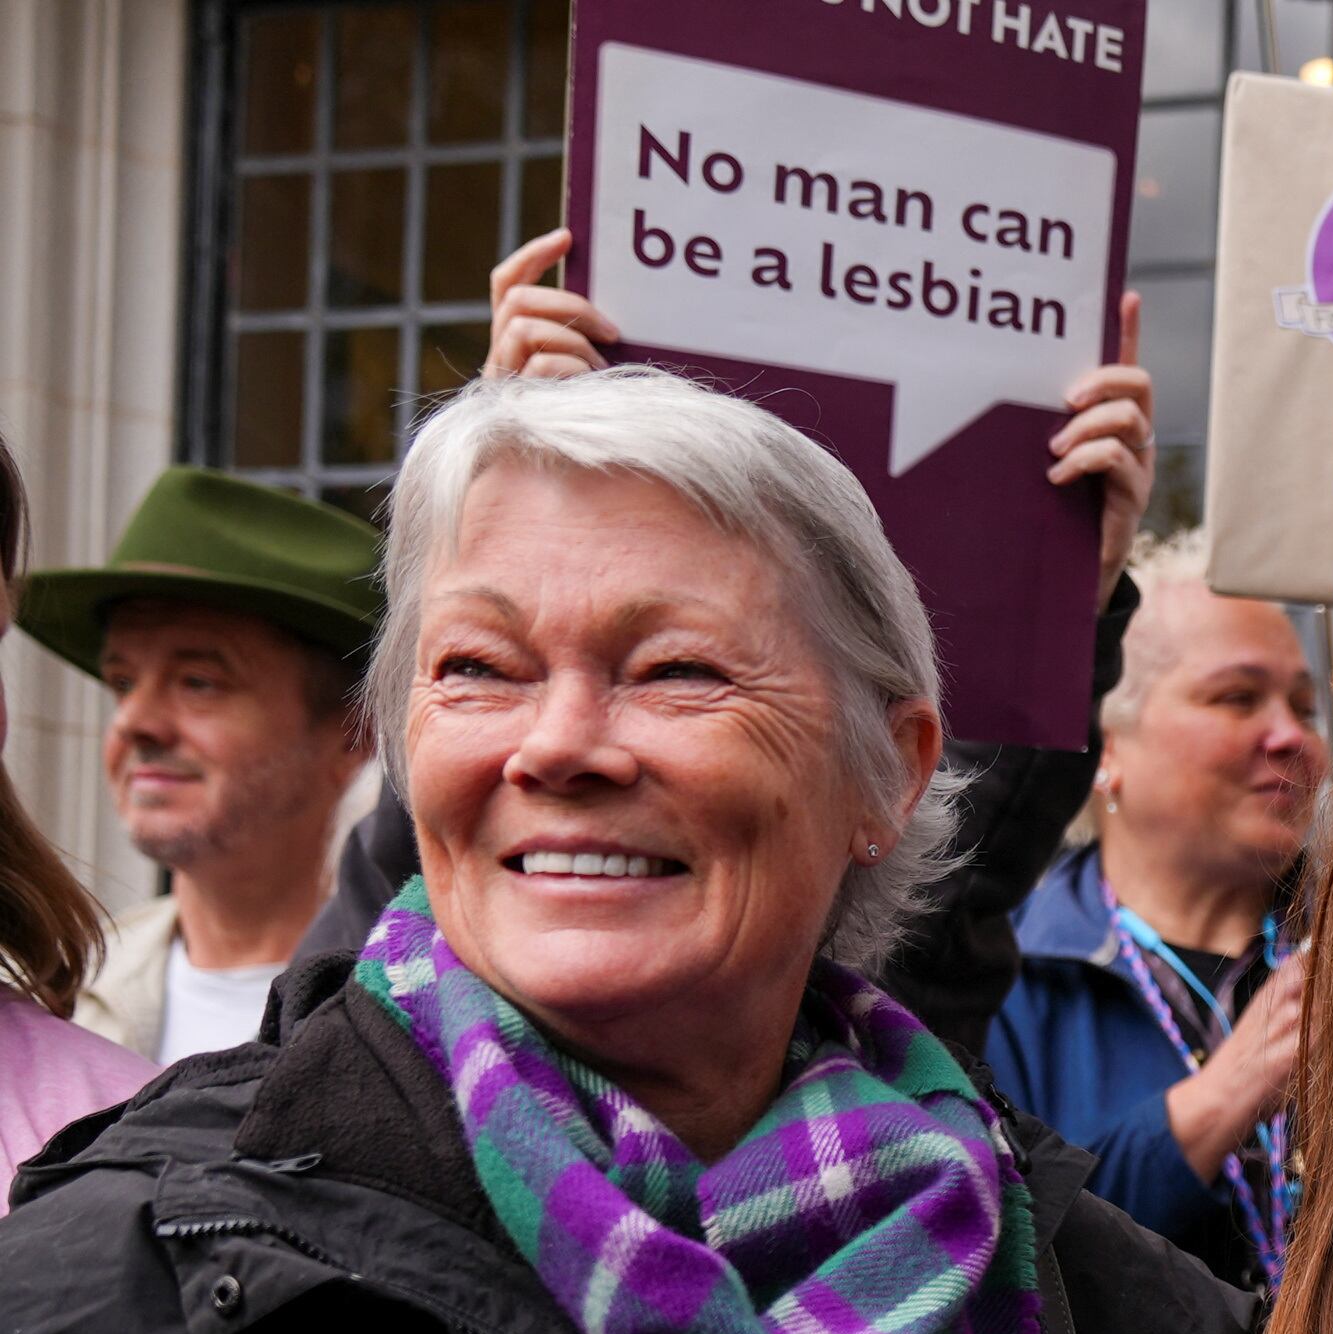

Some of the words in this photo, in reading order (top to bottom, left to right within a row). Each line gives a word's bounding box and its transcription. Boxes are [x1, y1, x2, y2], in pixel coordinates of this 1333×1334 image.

[861, 0, 980, 35] OT
[991, 0, 1125, 73] HATE
[638, 123, 744, 194] No
[775, 163, 934, 231] man
[962, 201, 1075, 259] can
[634, 209, 724, 277] be
[751, 247, 792, 291] a
[821, 243, 1067, 338] lesbian
